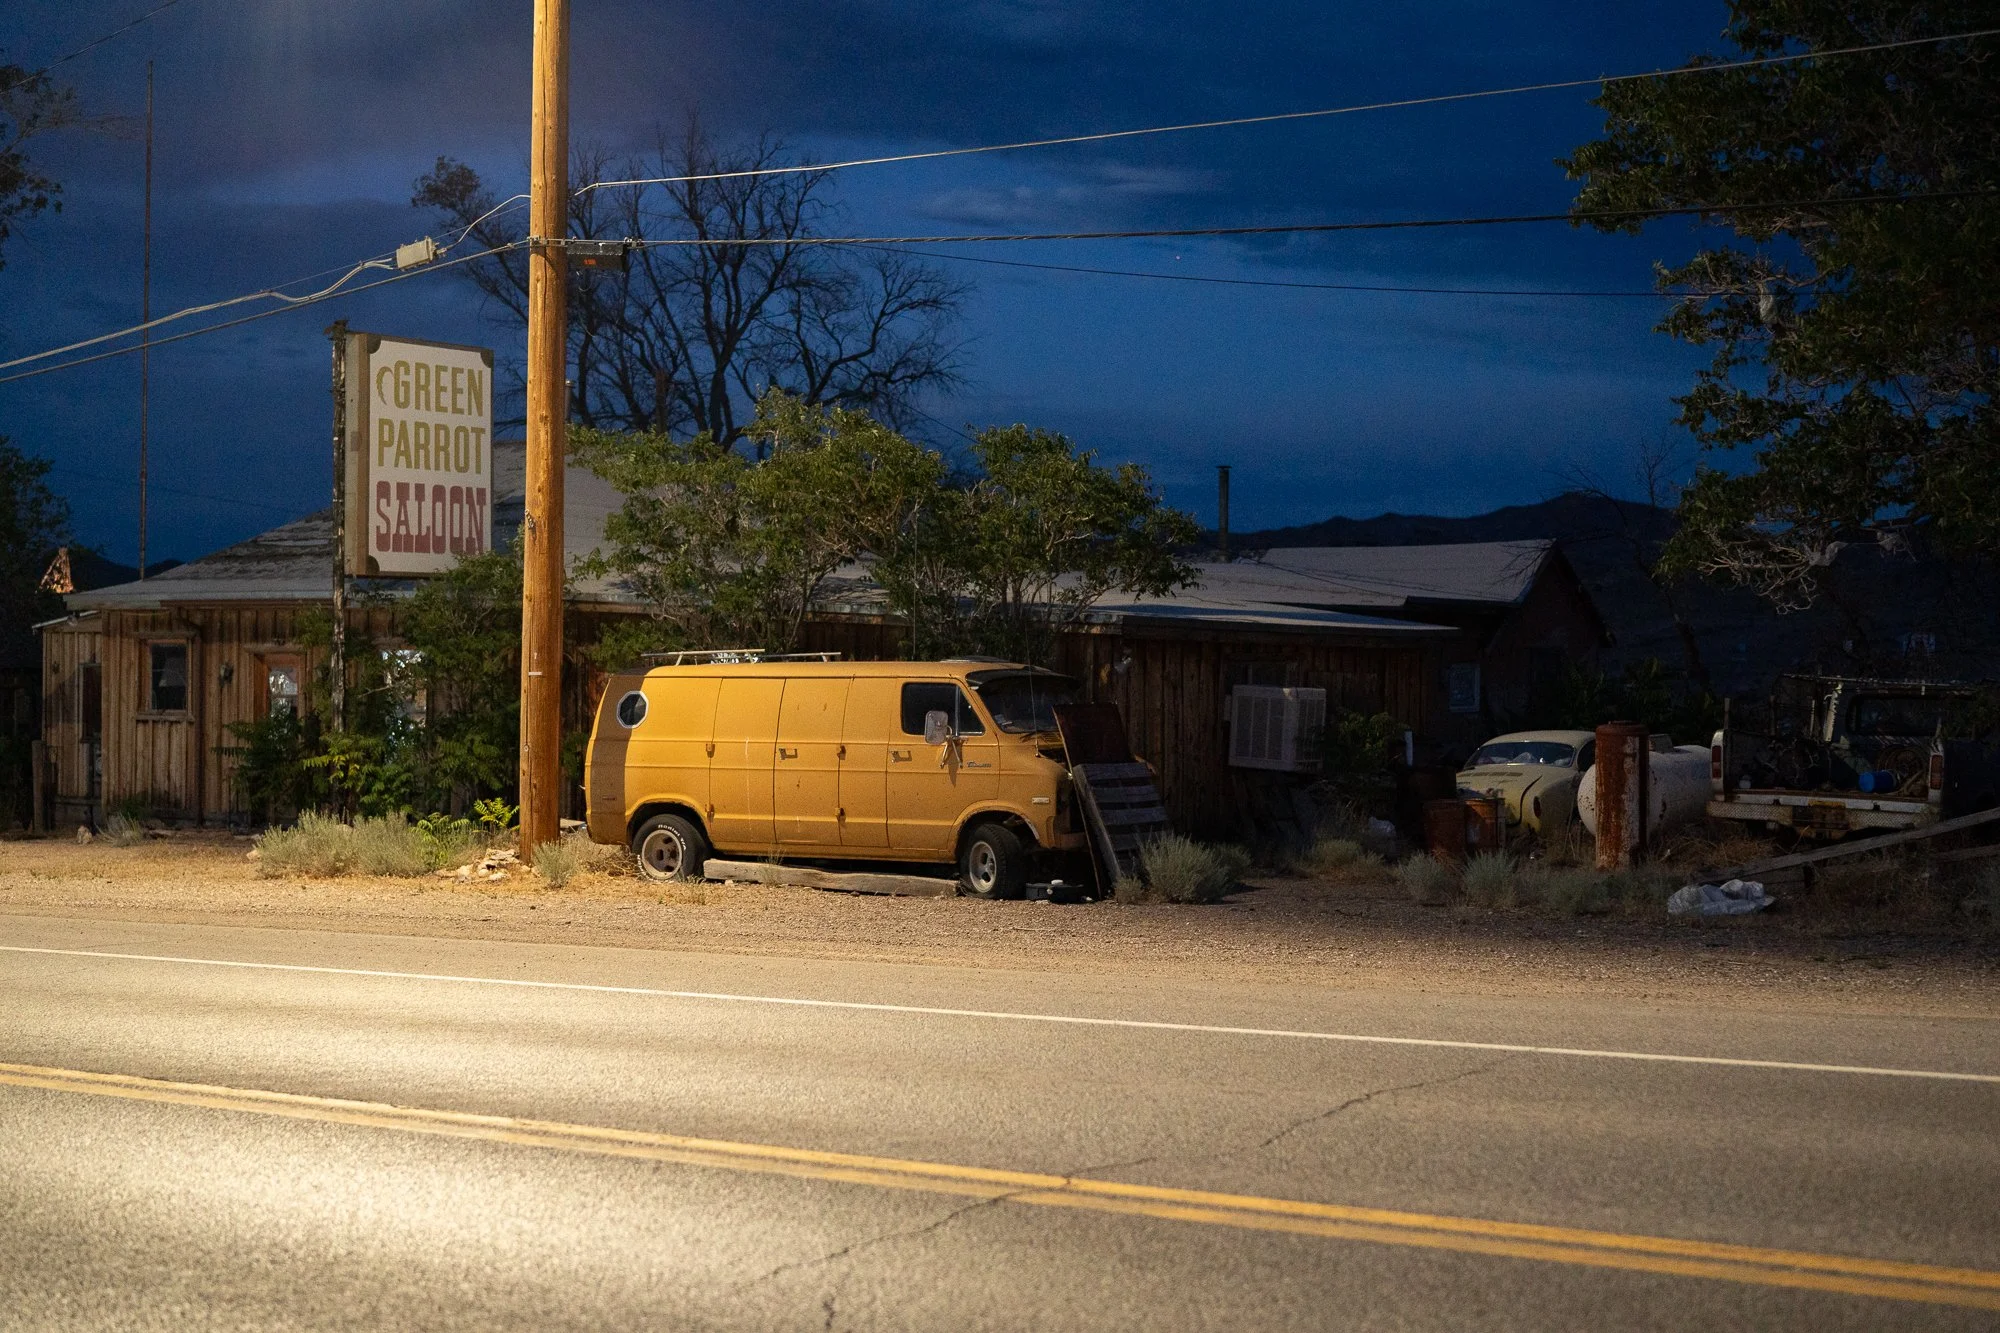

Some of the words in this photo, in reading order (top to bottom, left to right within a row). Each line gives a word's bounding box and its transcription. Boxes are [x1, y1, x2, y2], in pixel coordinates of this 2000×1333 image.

[393, 360, 483, 417] GREEN
[377, 418, 486, 475] PARROT
[376, 480, 487, 554] SALOON
